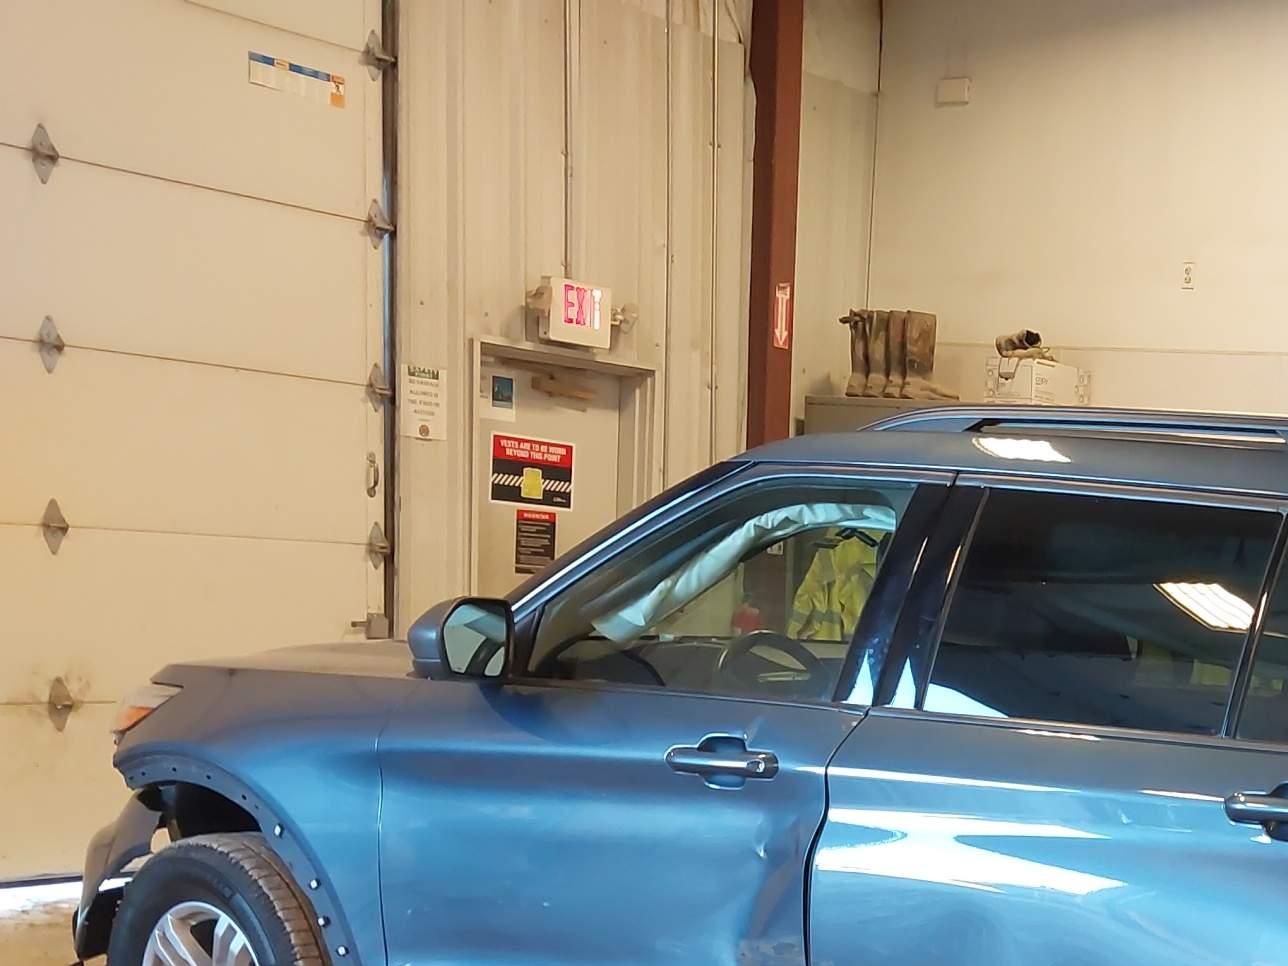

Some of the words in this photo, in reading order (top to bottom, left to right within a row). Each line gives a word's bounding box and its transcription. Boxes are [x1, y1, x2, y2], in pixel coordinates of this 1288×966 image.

[564, 284, 602, 330] EXIT
[500, 439, 519, 449] VESTS
[519, 441, 531, 451] ARE
[532, 443, 540, 452] TO
[540, 445, 548, 453] BE
[505, 448, 529, 458] BEYOND
[530, 451, 543, 460] THIS
[543, 453, 561, 463] POINT
